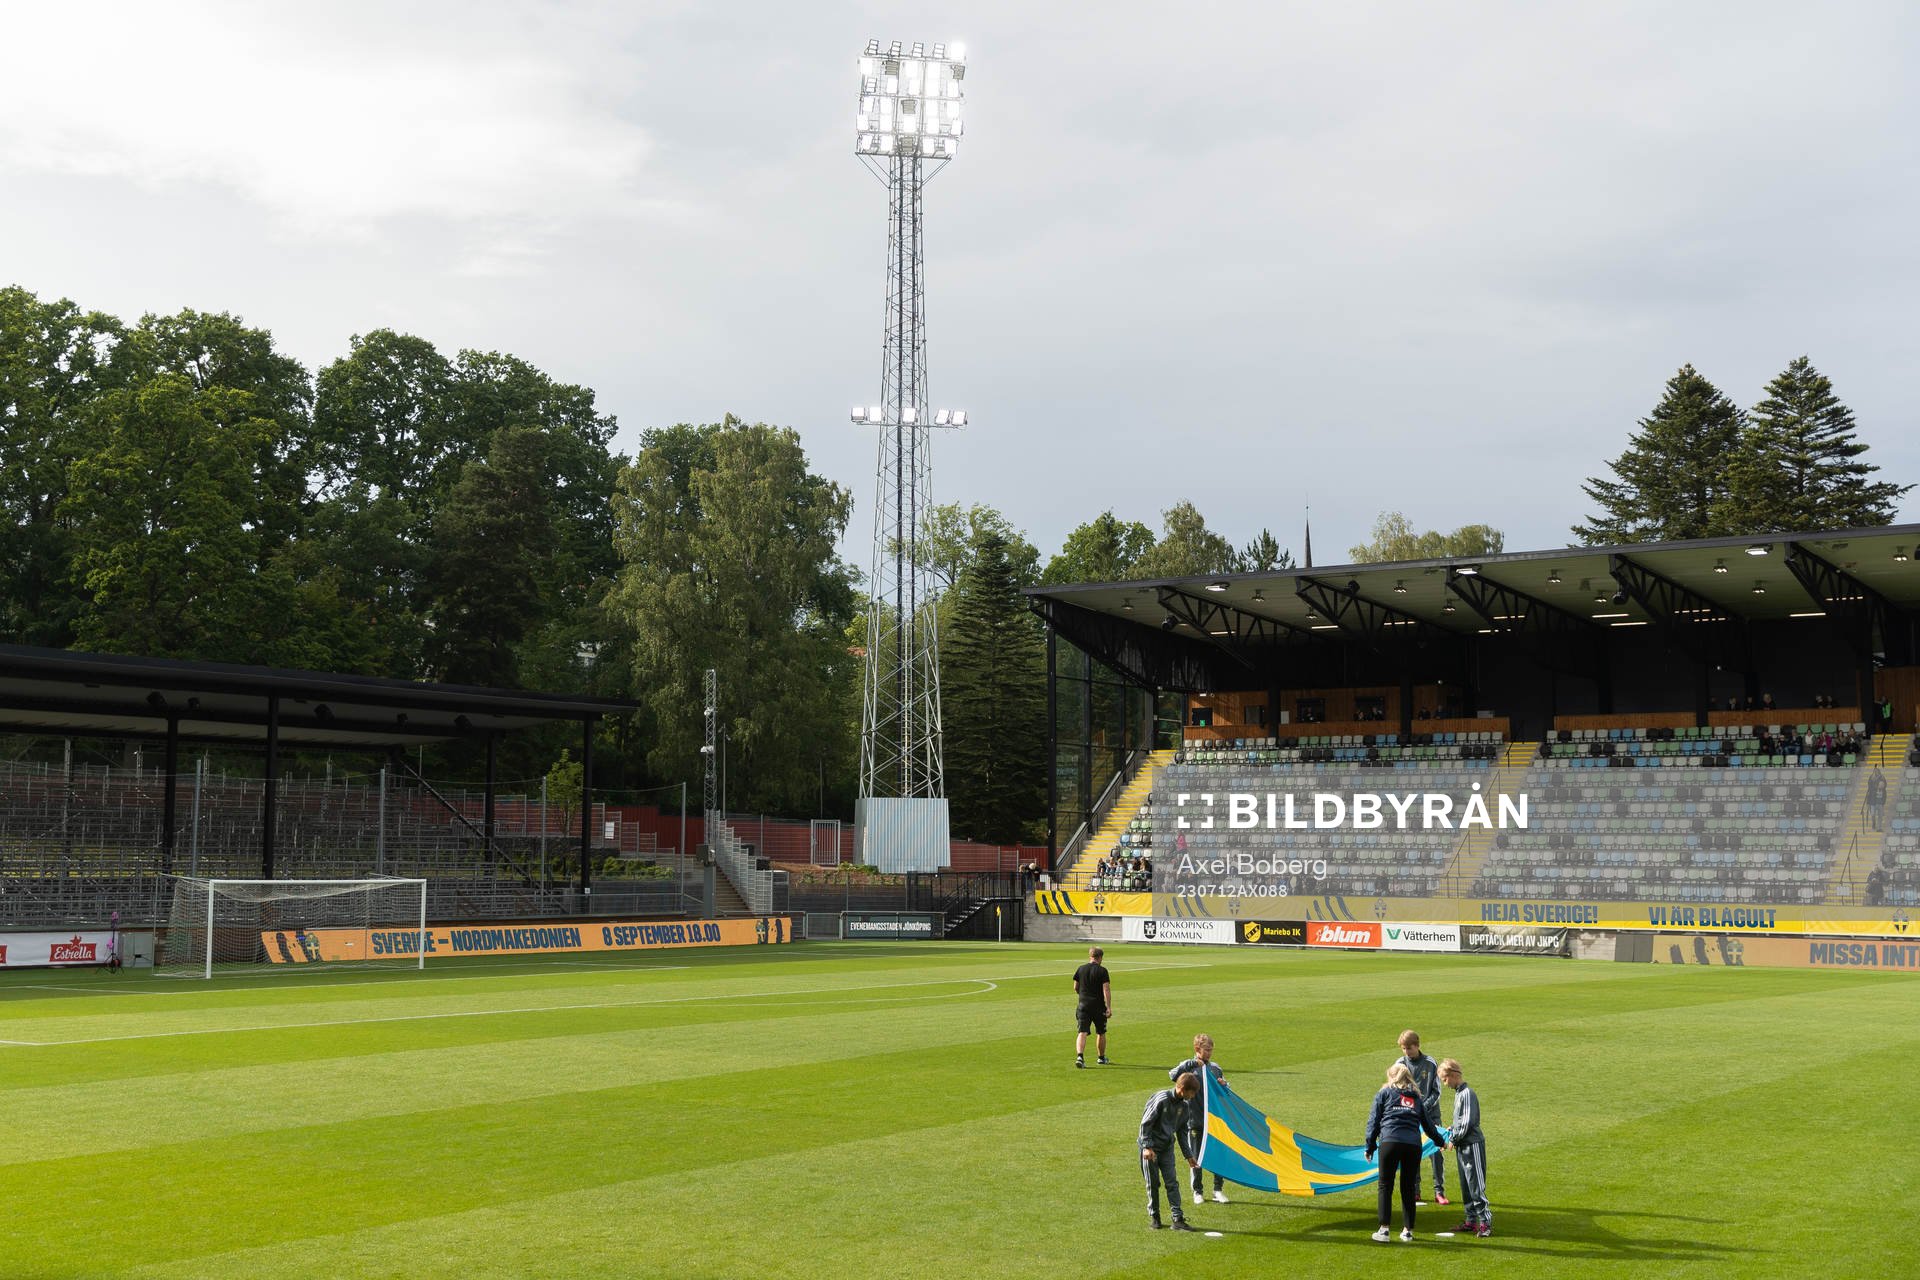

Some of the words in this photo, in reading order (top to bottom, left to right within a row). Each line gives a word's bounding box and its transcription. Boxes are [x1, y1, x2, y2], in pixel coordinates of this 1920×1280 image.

[1481, 903, 1519, 921] HEJA
[1523, 905, 1598, 924] SVERIGE!
[1649, 906, 1666, 925] VI
[1670, 905, 1695, 926] ÄR
[1699, 907, 1777, 928] BLÅGULT
[450, 927, 582, 951] NORDMAKEDONIEN
[602, 927, 613, 947] 8
[614, 925, 687, 946] SEPTEMBER
[688, 923, 722, 943] 18.00
[1159, 930, 1202, 939] KOMMUN
[1263, 927, 1291, 936] Mariebo
[1292, 928, 1301, 936] IK
[1320, 925, 1370, 943] blum
[1403, 930, 1456, 942] Vätterhem
[1506, 935, 1524, 946] MER
[1525, 935, 1536, 946] AV
[1537, 936, 1559, 948] JKPG
[54, 945, 92, 960] Estrella
[1809, 943, 1878, 966] MISSA
[1882, 944, 1920, 967] INT
